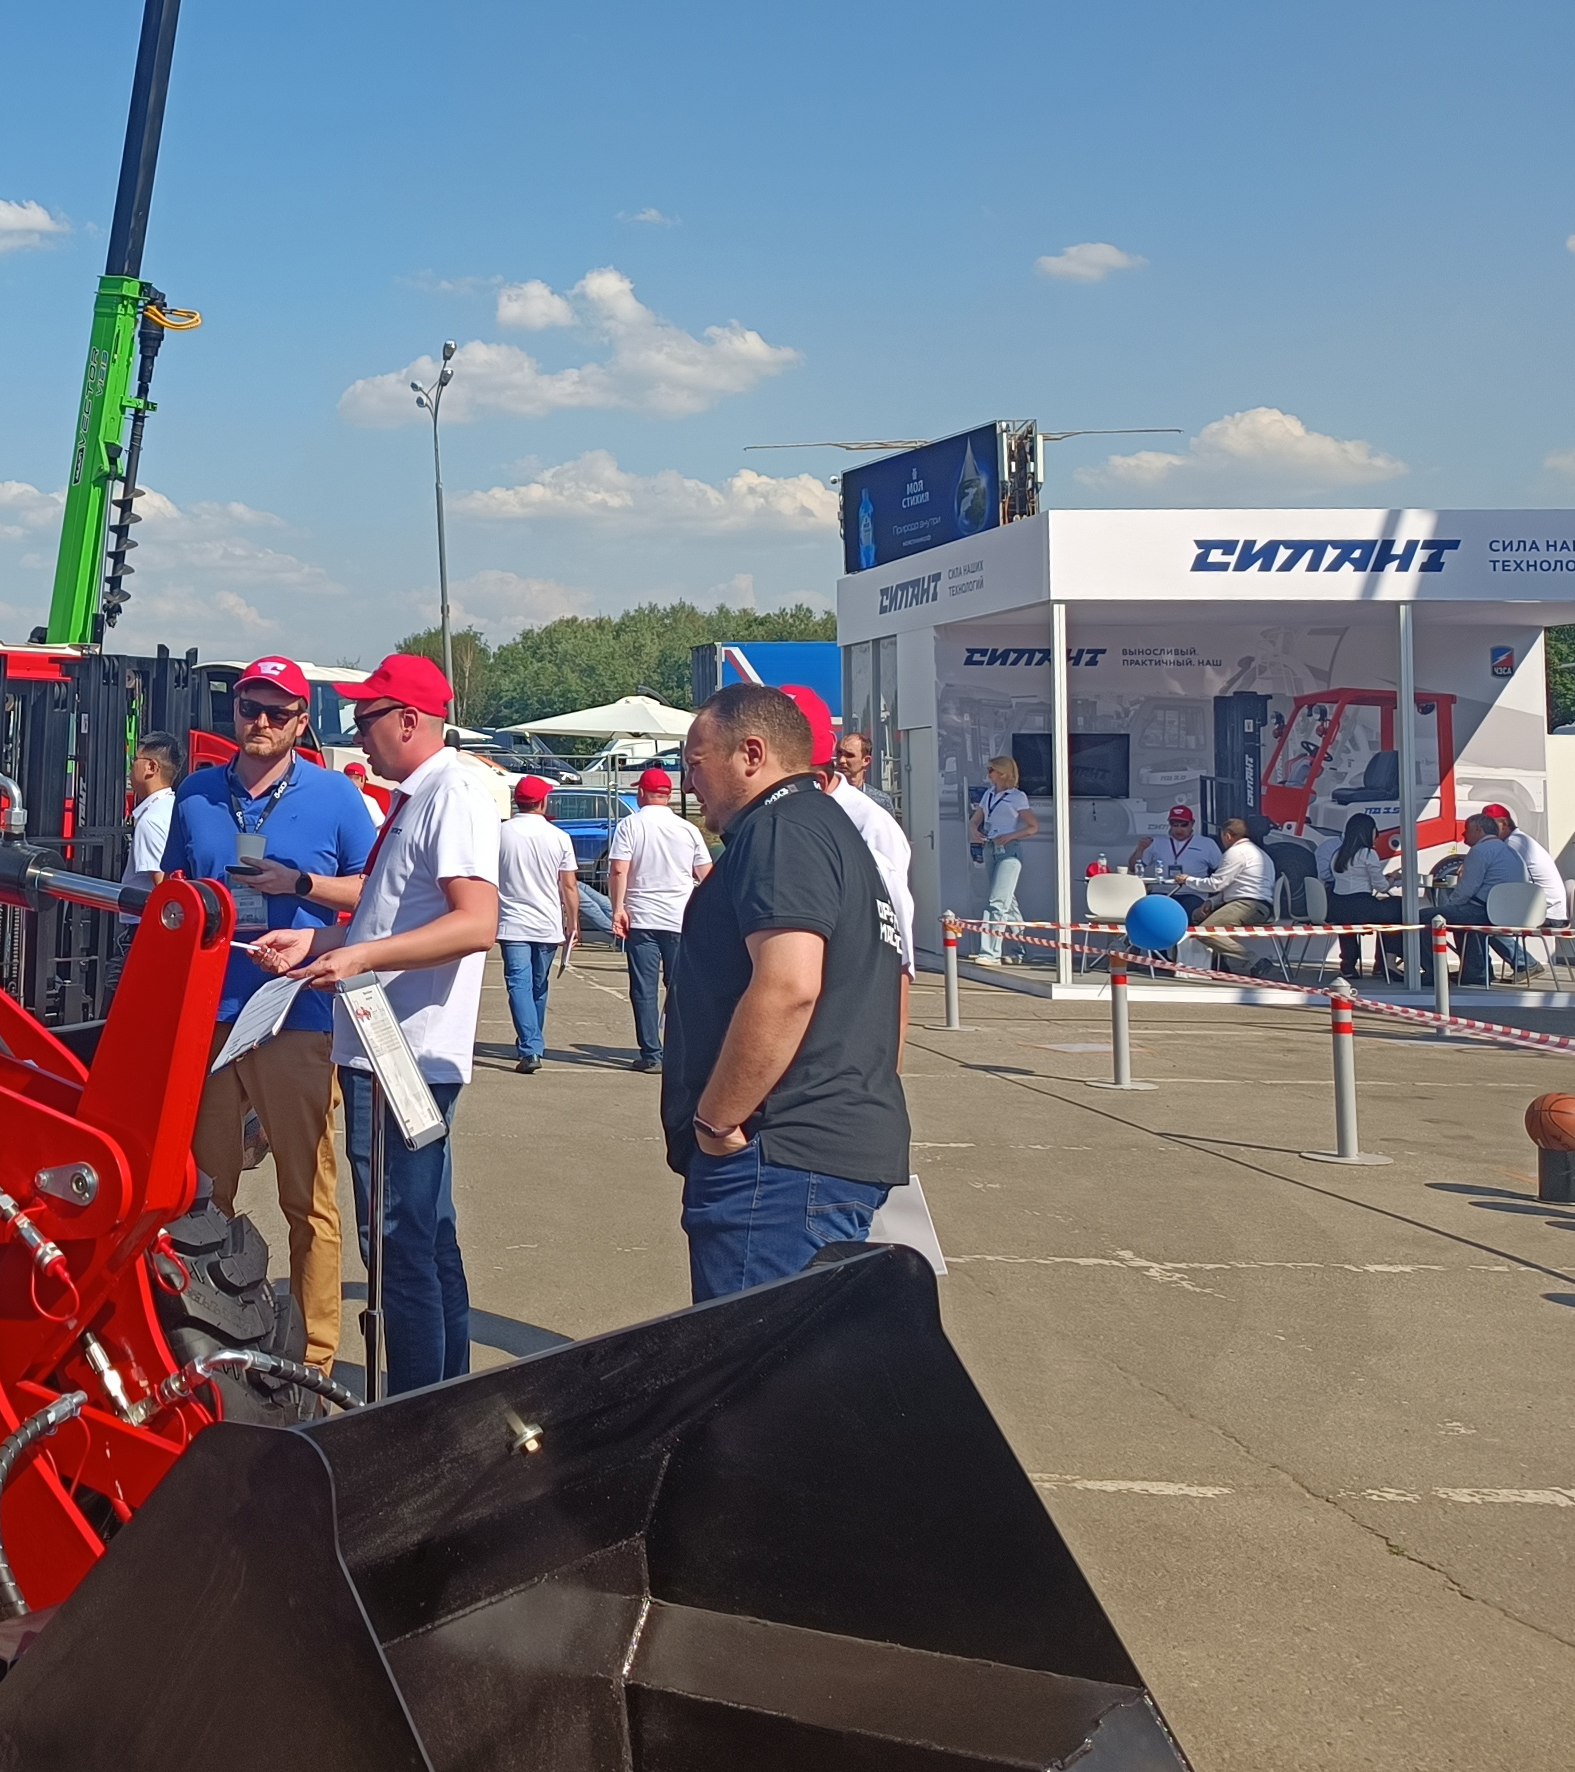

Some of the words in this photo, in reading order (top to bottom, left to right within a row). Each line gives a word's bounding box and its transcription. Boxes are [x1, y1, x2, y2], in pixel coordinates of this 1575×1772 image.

[1489, 540, 1540, 552] СИЛА
[1546, 540, 1575, 552] НА
[1189, 539, 1461, 572] СИЛАНТ
[879, 571, 942, 615] СИЛАНТ
[1122, 648, 1199, 656] ВЫНОСЛИВЫЙ.
[1121, 658, 1195, 667] ПРАКТИЧНЫЙ.
[1198, 659, 1222, 667] НАШ
